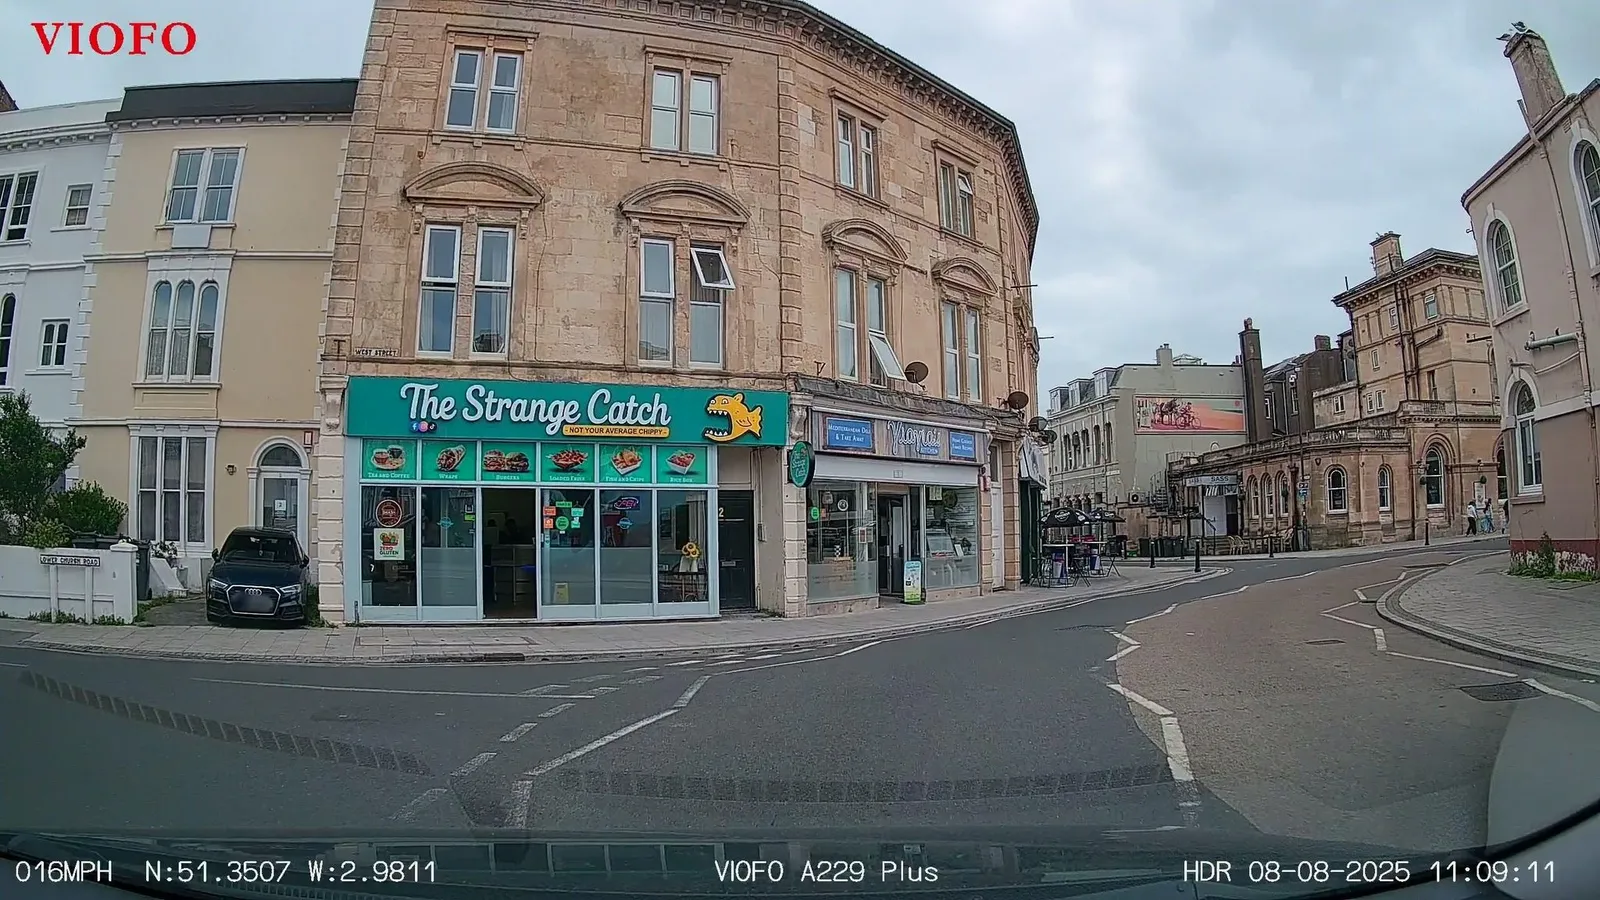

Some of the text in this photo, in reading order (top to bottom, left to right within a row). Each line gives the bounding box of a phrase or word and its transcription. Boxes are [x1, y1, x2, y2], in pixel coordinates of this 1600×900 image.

[400, 383, 671, 435] The Strange Catch
[605, 427, 637, 435] AVERAGE
[718, 507, 724, 518] 2
